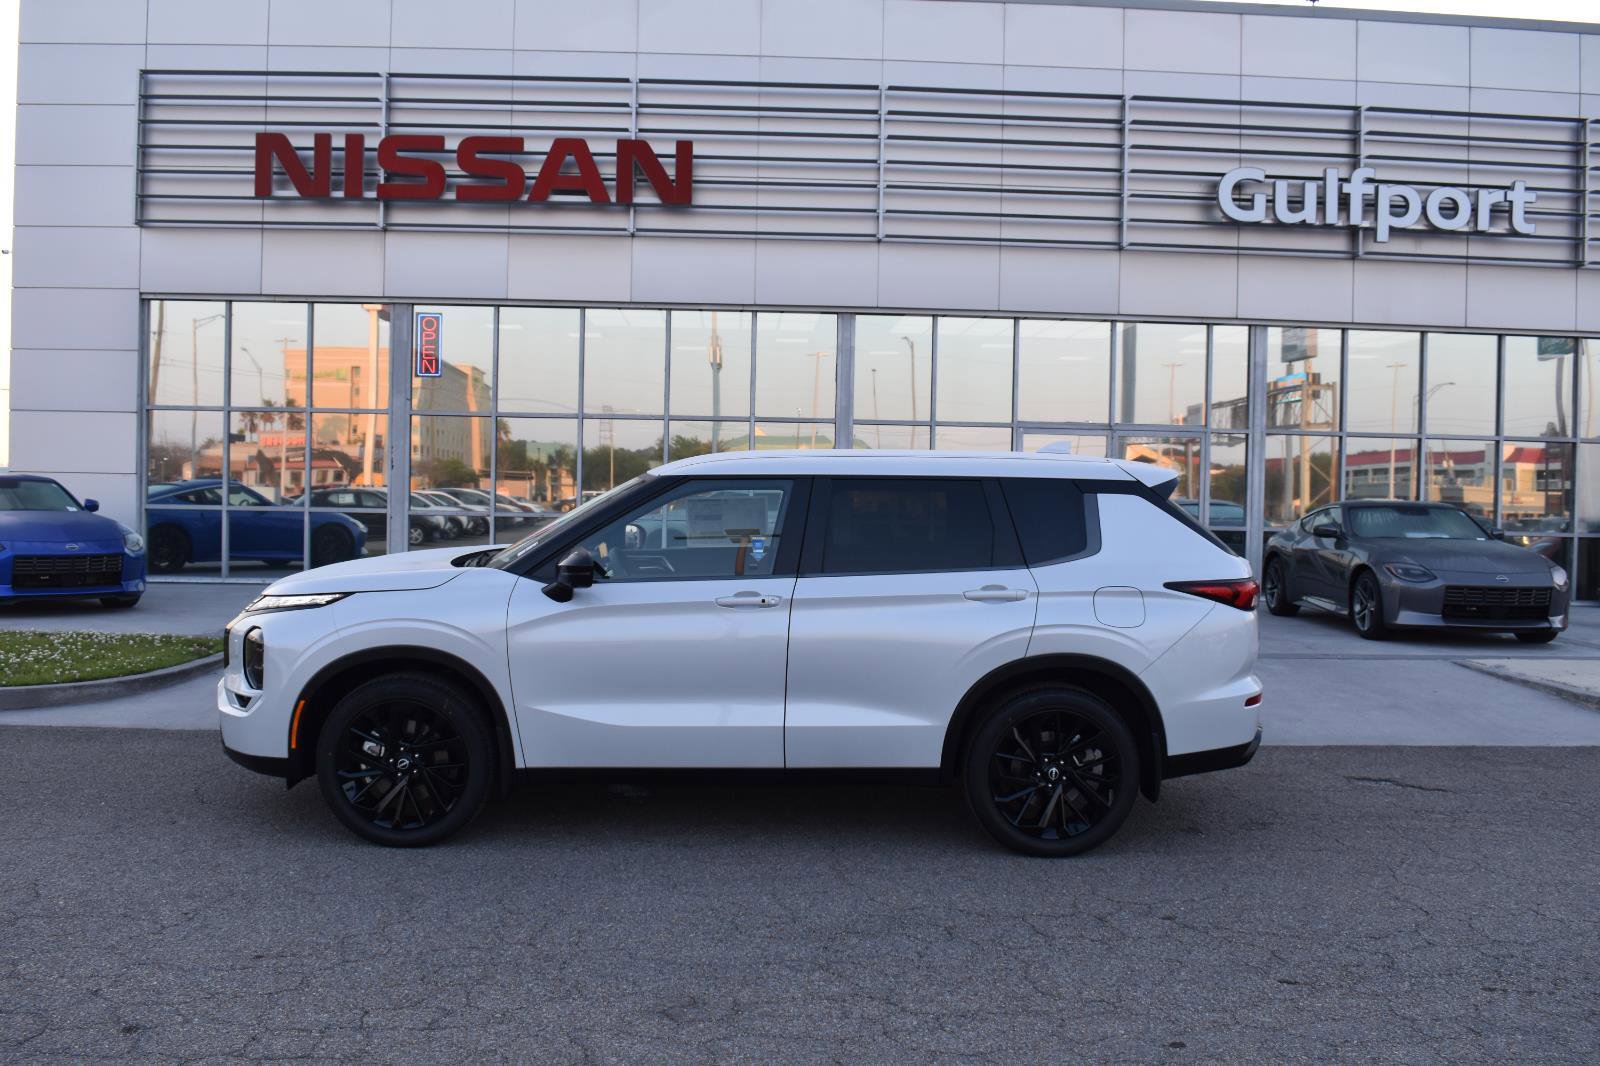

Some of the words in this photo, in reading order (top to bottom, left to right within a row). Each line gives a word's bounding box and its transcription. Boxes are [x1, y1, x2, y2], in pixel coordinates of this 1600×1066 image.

[254, 132, 693, 205] NISSAN
[1218, 166, 1536, 243] Gulfport
[422, 316, 437, 373] OPEN
